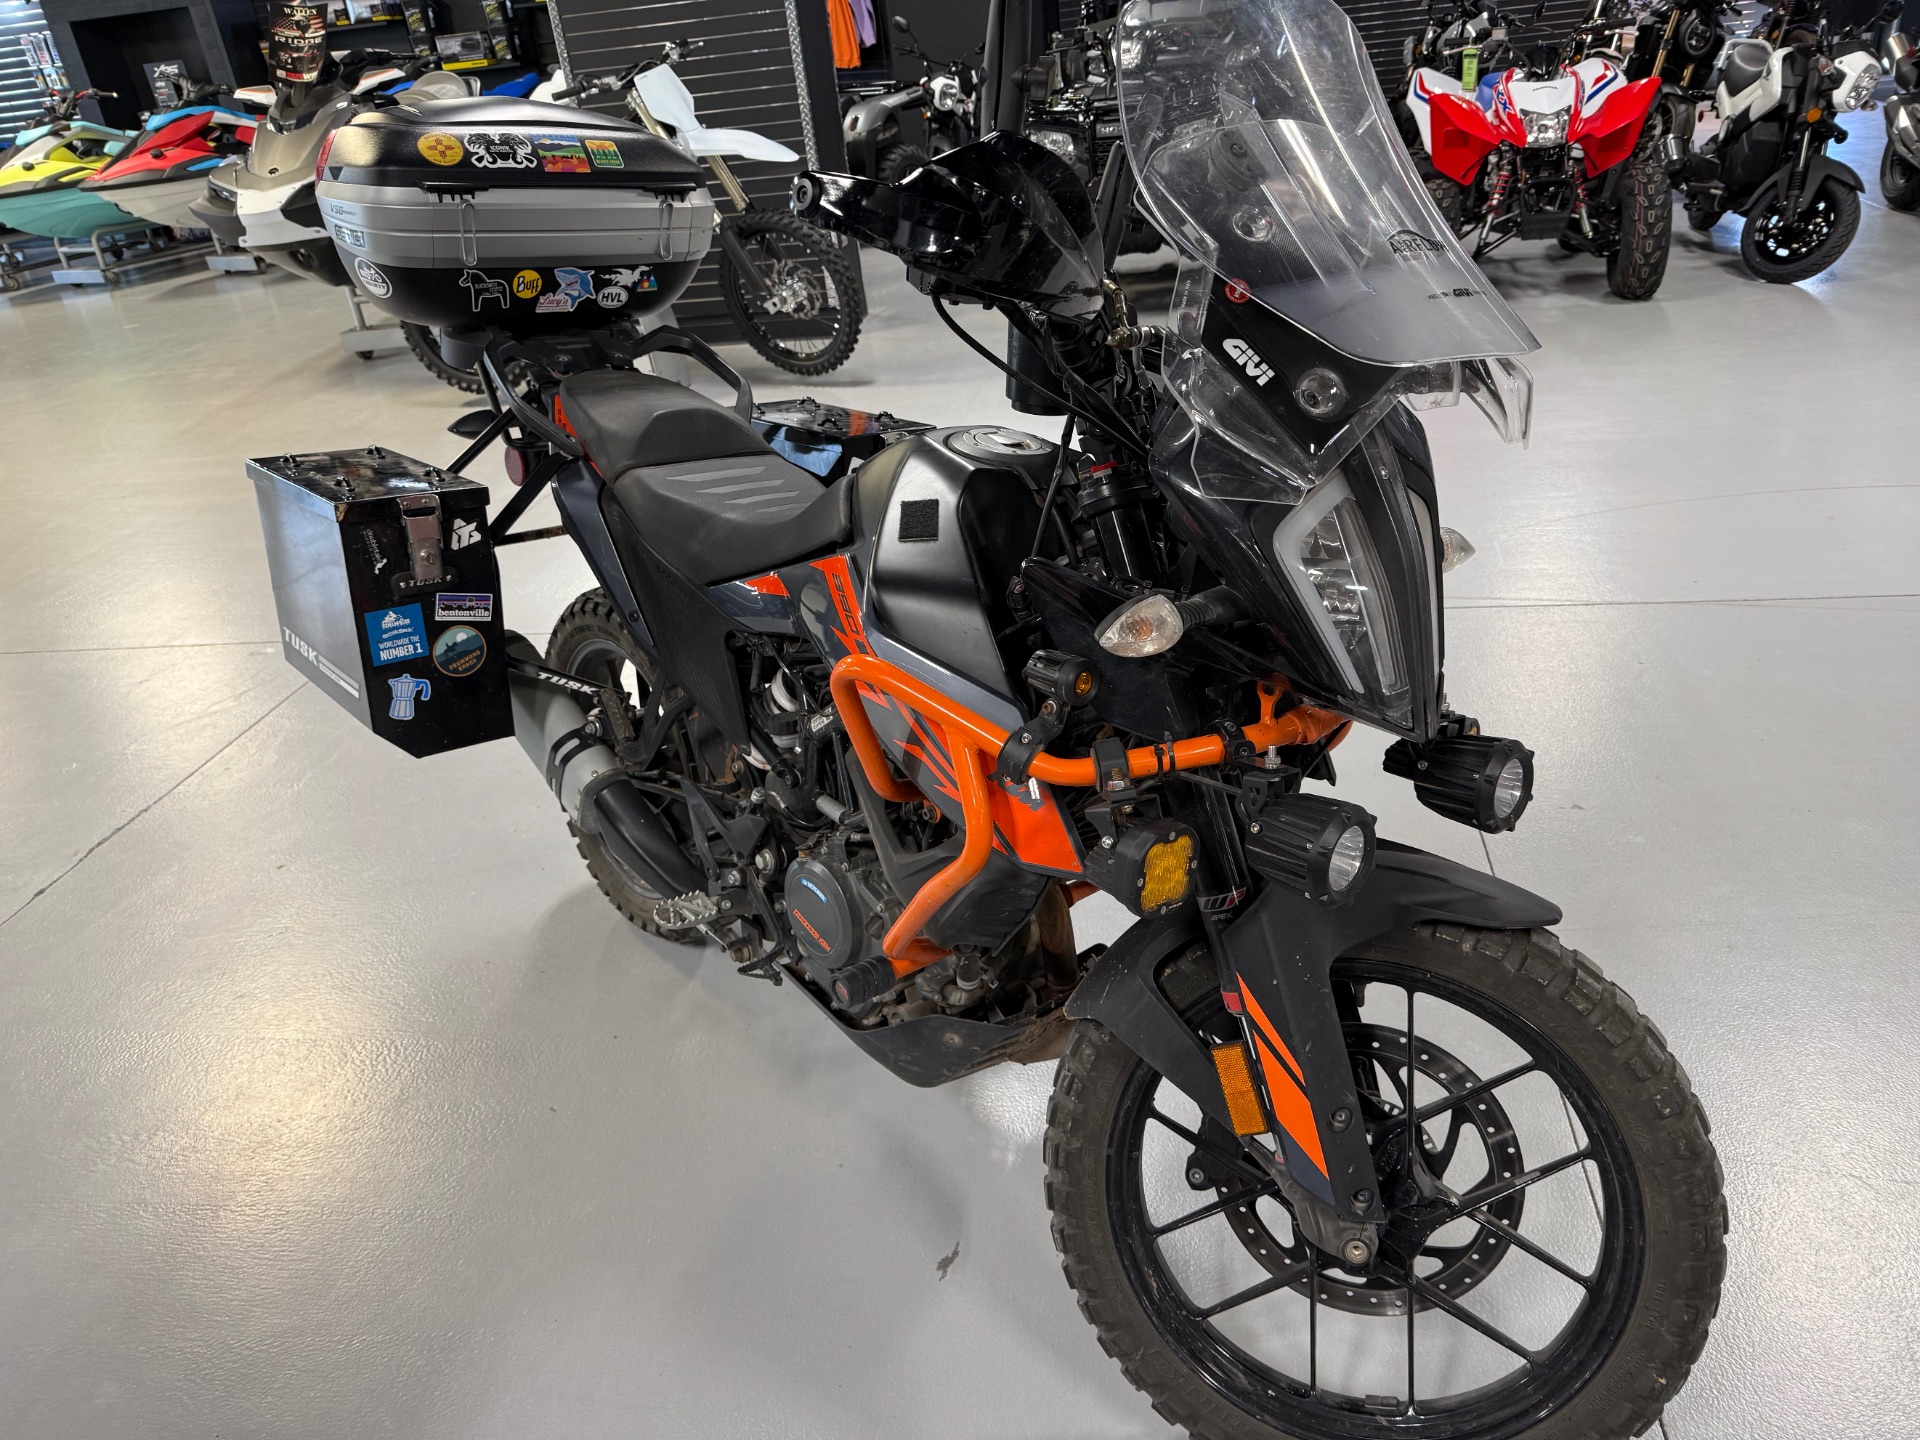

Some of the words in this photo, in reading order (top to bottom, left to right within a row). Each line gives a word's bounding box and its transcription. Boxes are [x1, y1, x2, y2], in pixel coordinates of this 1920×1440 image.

[601, 293, 623, 303] HVL
[1222, 338, 1276, 387] GIVI
[438, 608, 490, 617] bentonville
[283, 626, 319, 667] TUSK
[378, 636, 410, 650] WORLDWIDE
[411, 635, 421, 643] THE
[380, 644, 415, 661] NUMBER
[416, 642, 424, 653] 1
[537, 671, 600, 695] TUSK
[1211, 912, 1233, 921] APEX
